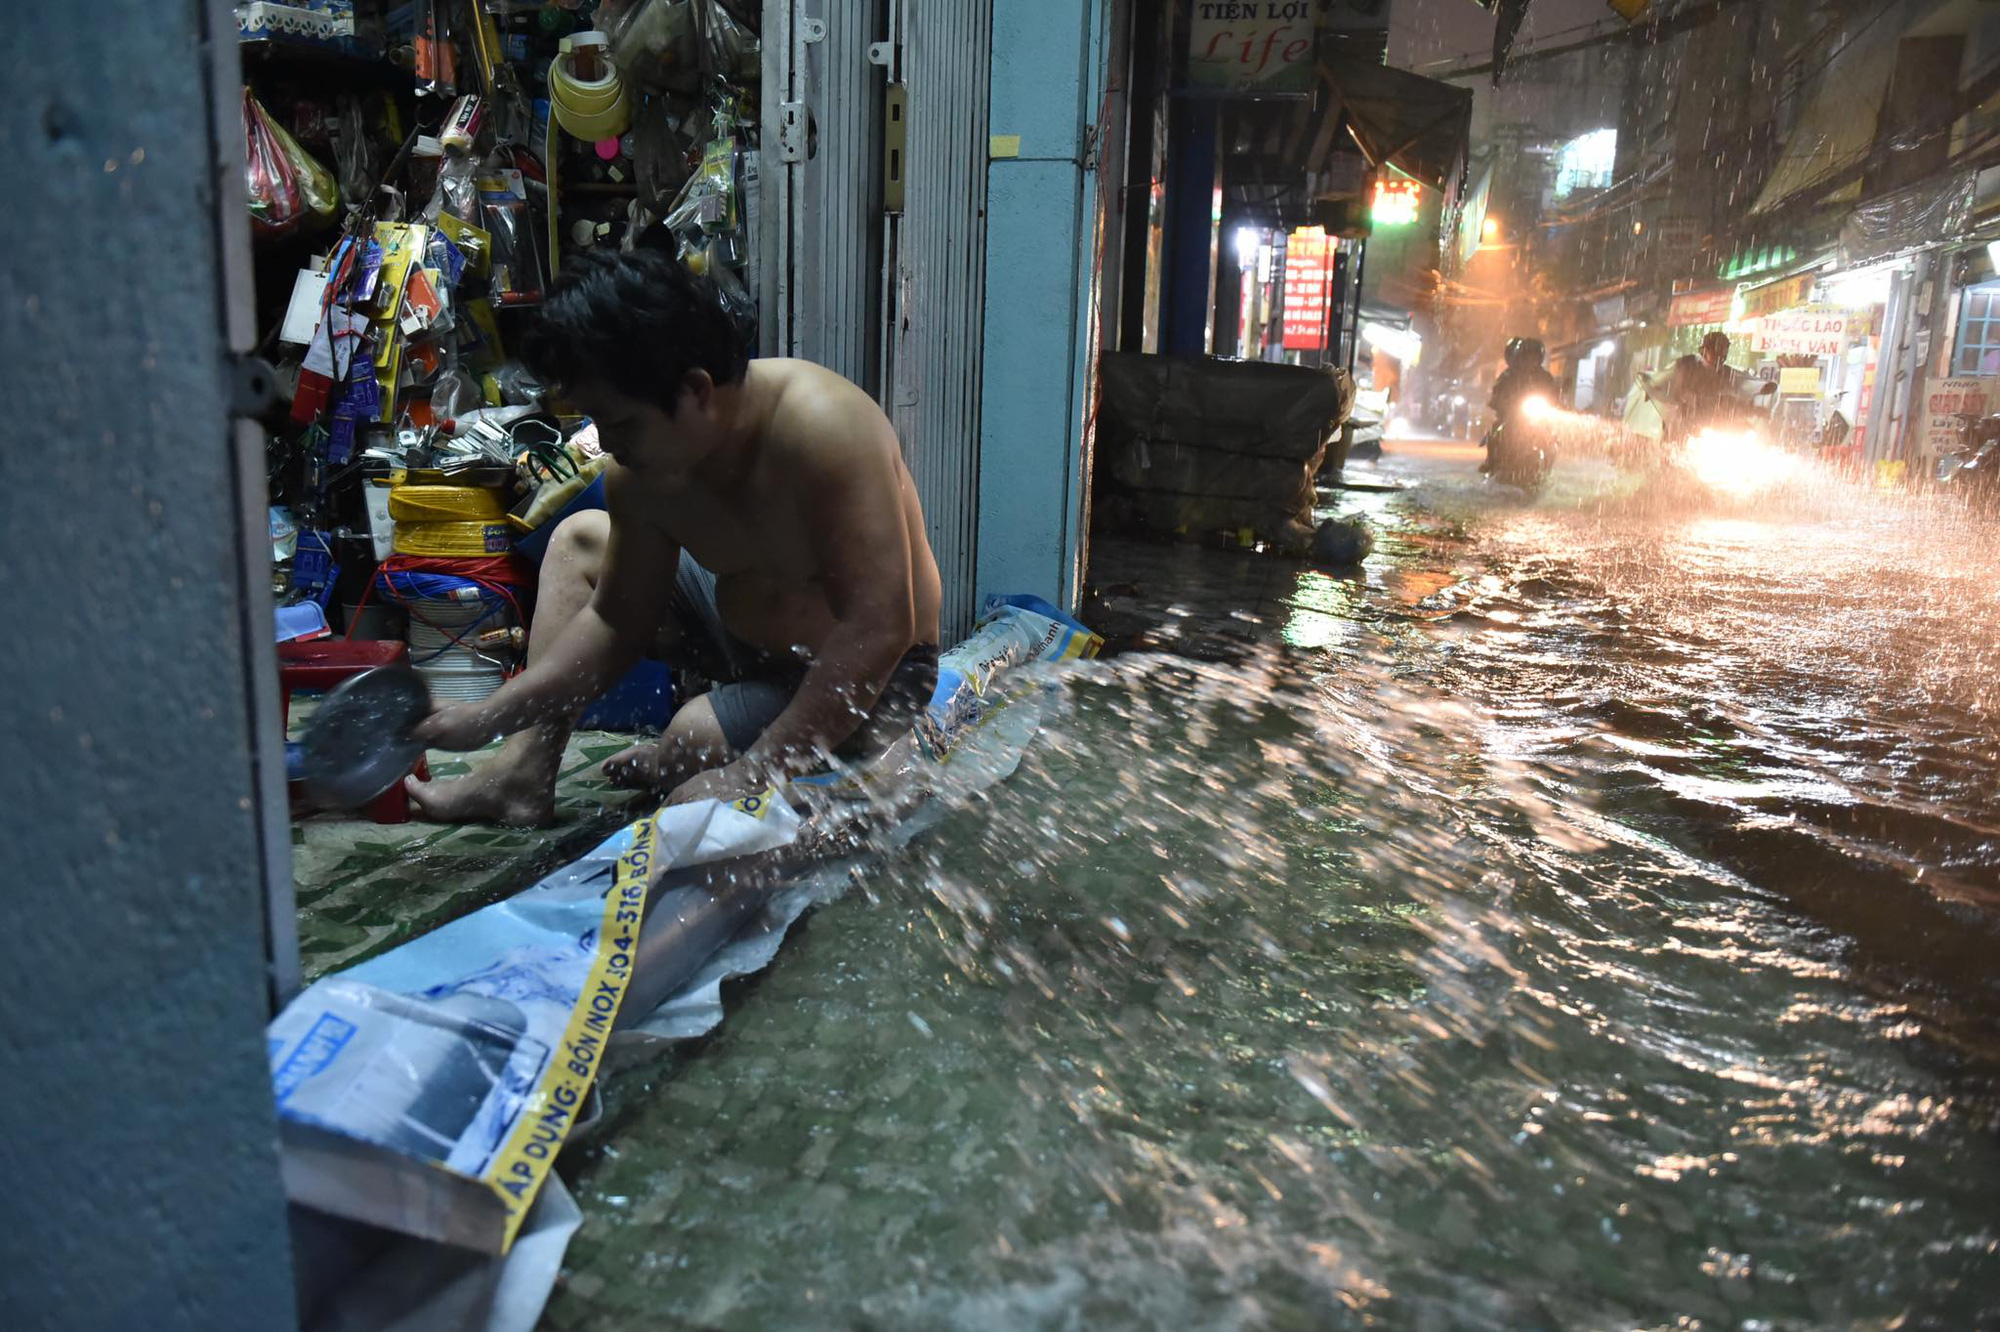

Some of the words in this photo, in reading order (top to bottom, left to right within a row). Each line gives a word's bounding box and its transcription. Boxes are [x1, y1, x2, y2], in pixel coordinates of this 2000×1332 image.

[1266, 0, 1310, 22] LỢI
[1196, 25, 1310, 77] Life
[585, 983, 620, 1034] INOX
